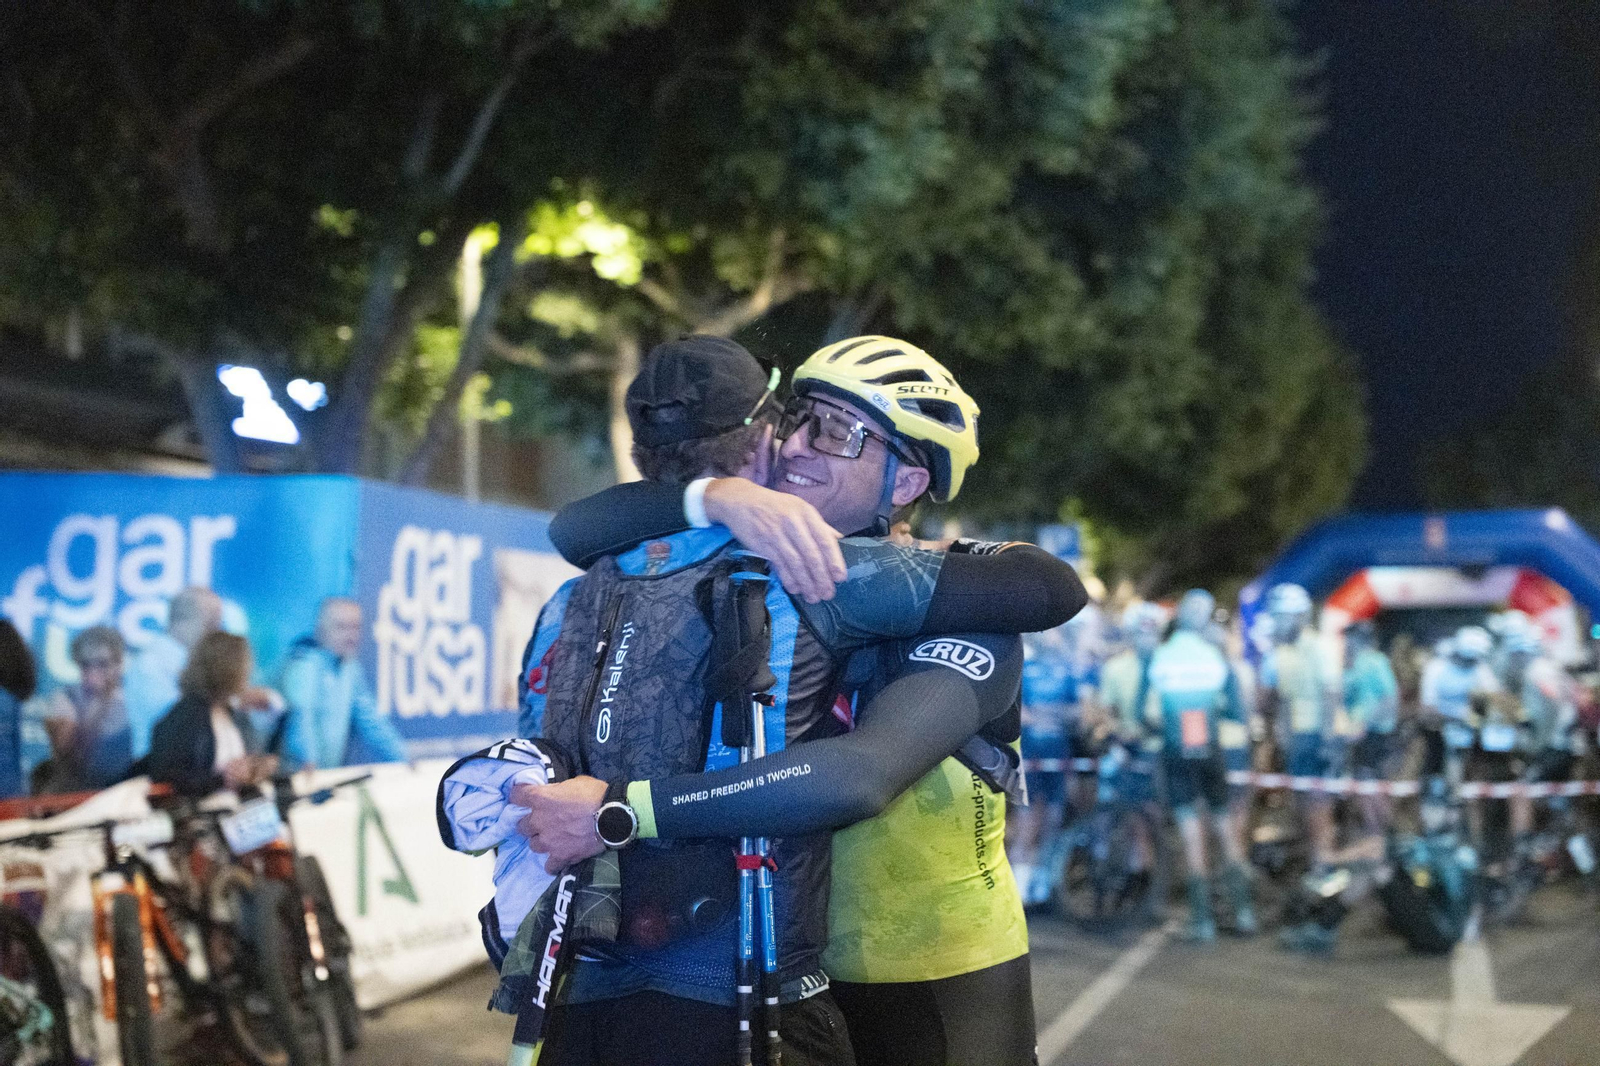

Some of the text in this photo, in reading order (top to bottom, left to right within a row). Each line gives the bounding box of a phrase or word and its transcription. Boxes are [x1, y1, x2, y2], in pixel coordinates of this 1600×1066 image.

[896, 385, 950, 396] SCOTT
[46, 514, 237, 628] gar
[391, 524, 483, 651] gar
[373, 583, 487, 718] fusa
[915, 642, 990, 676] CRUZ
[672, 763, 812, 806] SHARED FREEDOM IS TWOFOLD
[532, 873, 577, 1010] HARMAN
